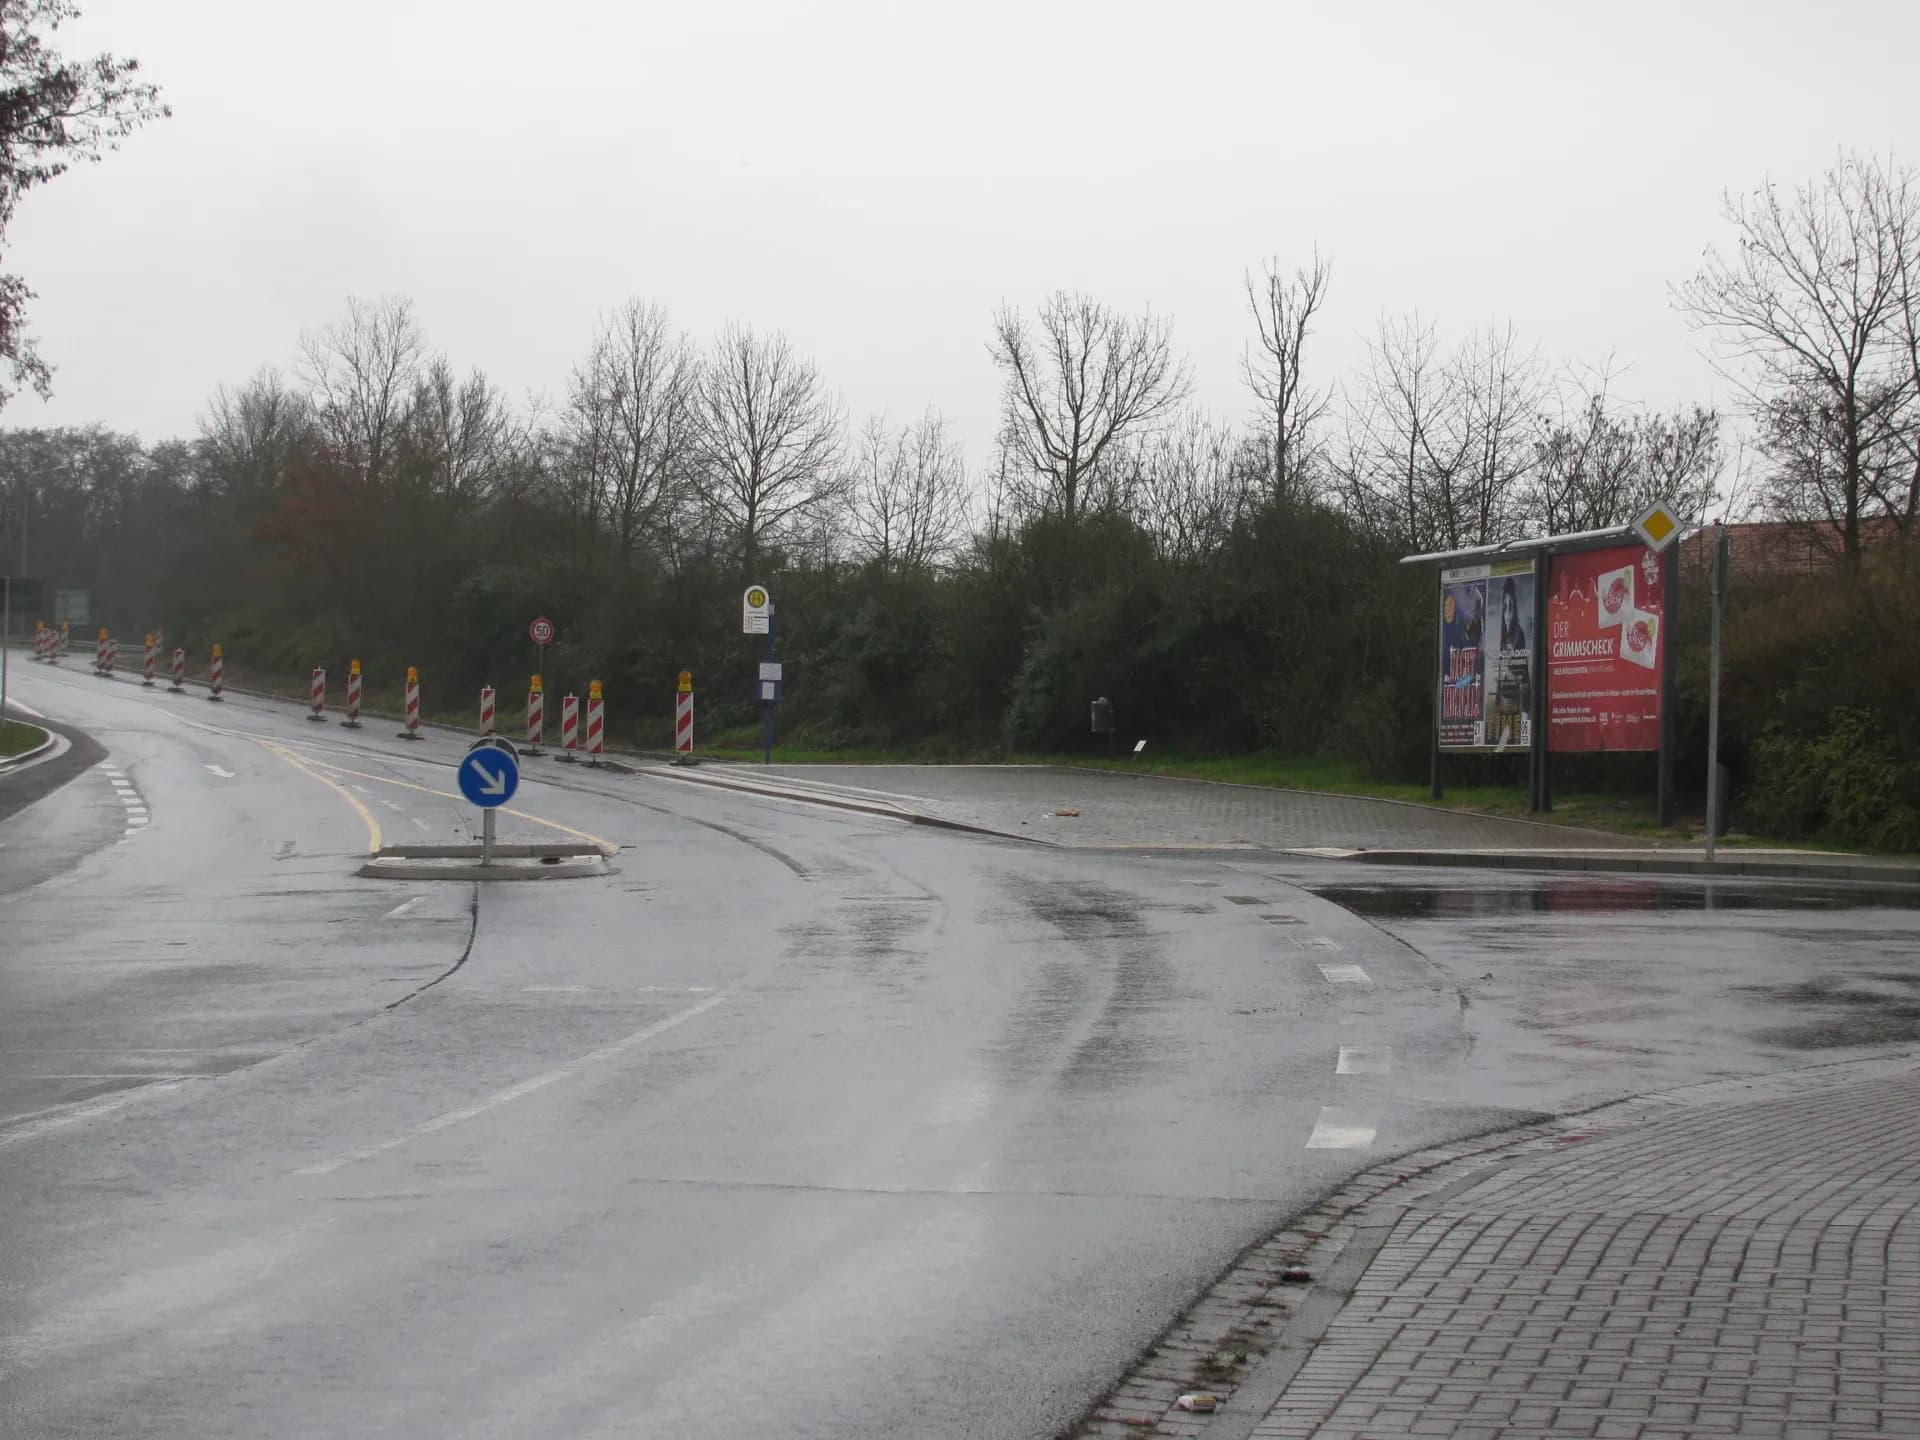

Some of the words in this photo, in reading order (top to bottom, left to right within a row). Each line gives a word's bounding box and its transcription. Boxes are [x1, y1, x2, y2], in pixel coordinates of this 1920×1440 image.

[536, 625, 549, 637] 50
[1553, 621, 1569, 639] DER
[1553, 638, 1614, 658] GRIMMSCHECK
